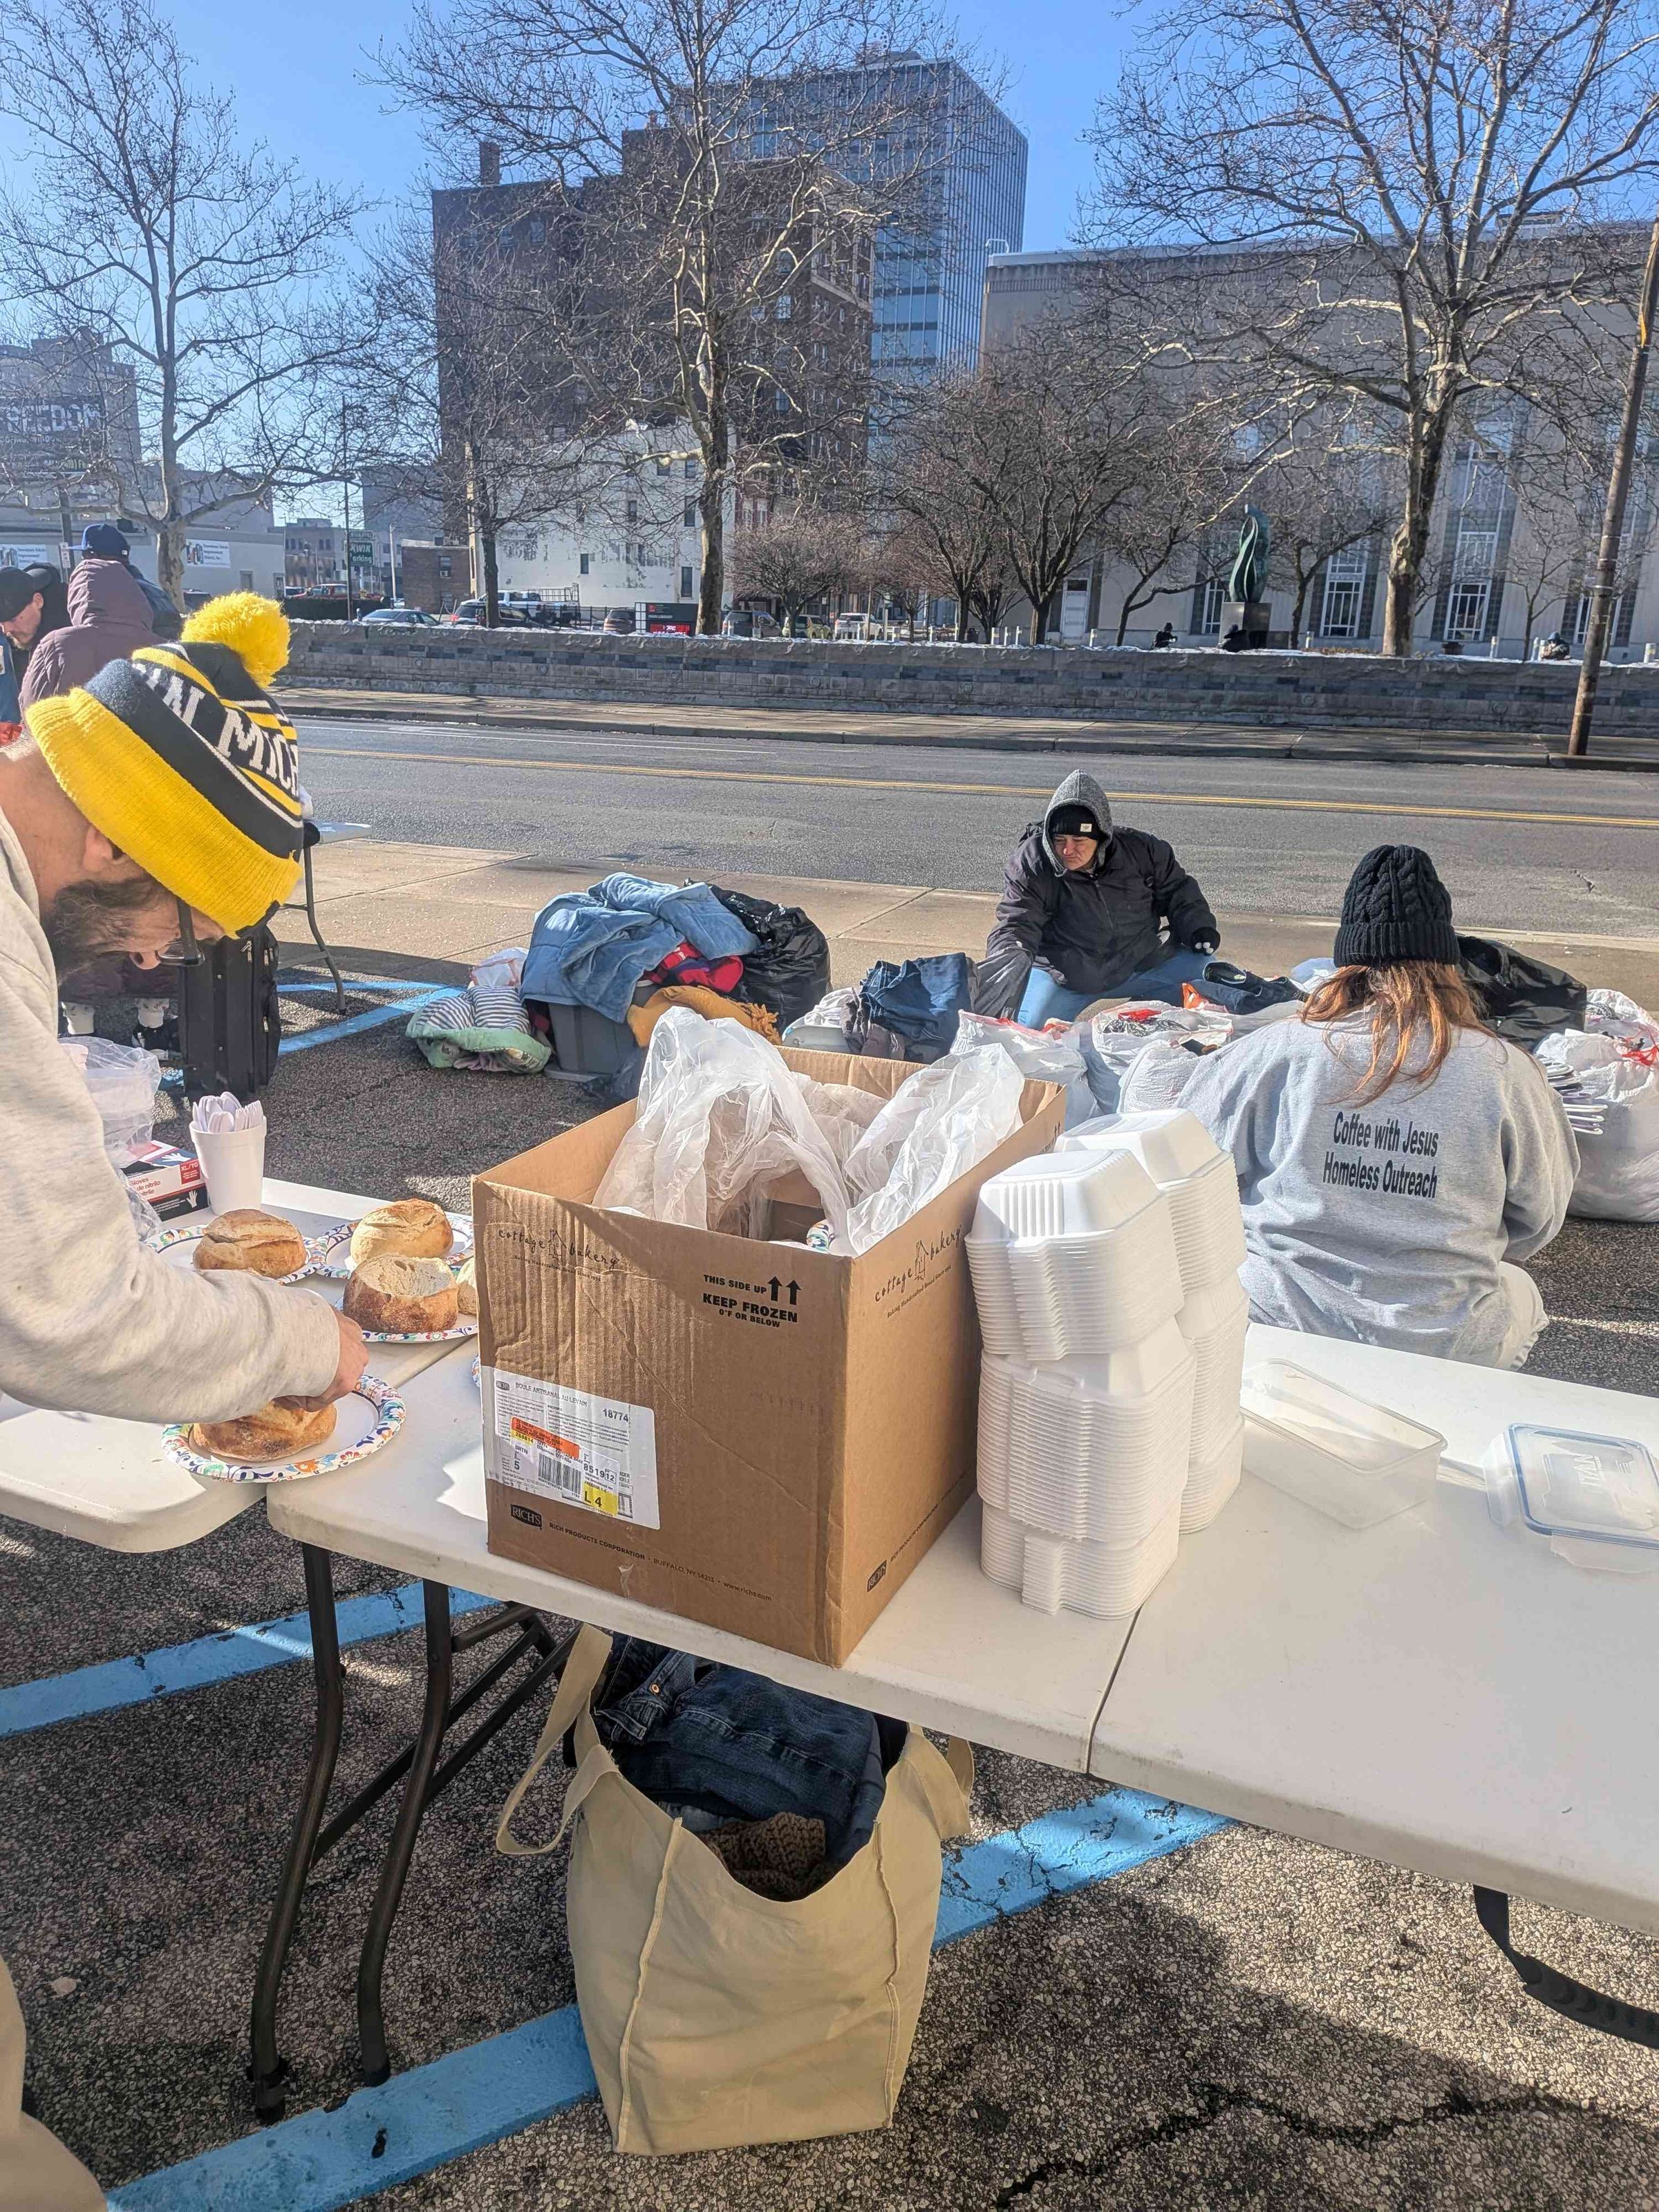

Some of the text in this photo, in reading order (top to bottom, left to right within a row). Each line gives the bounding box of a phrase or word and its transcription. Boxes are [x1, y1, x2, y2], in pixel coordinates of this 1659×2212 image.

[350, 553, 373, 564] arking
[1333, 1111, 1439, 1157] Coffee with Jesus
[1322, 1151, 1438, 1199] Homeless Outreach
[498, 1230, 619, 1271] cottage bakery
[875, 1228, 960, 1302] cottage bakery
[704, 1275, 767, 1294] THIS SIDE UP
[703, 1293, 797, 1322] KEEP FROZEN
[750, 1315, 780, 1328] BELOW
[603, 1408, 629, 1423] 18774
[514, 1460, 520, 1470] 5
[606, 1471, 615, 1482] 12
[584, 1490, 592, 1503] L
[594, 1497, 602, 1508] 4
[549, 1522, 772, 1602] RICH PRODUCTS CORPORATION BUFFALO, NY 14213 www.richs.com
